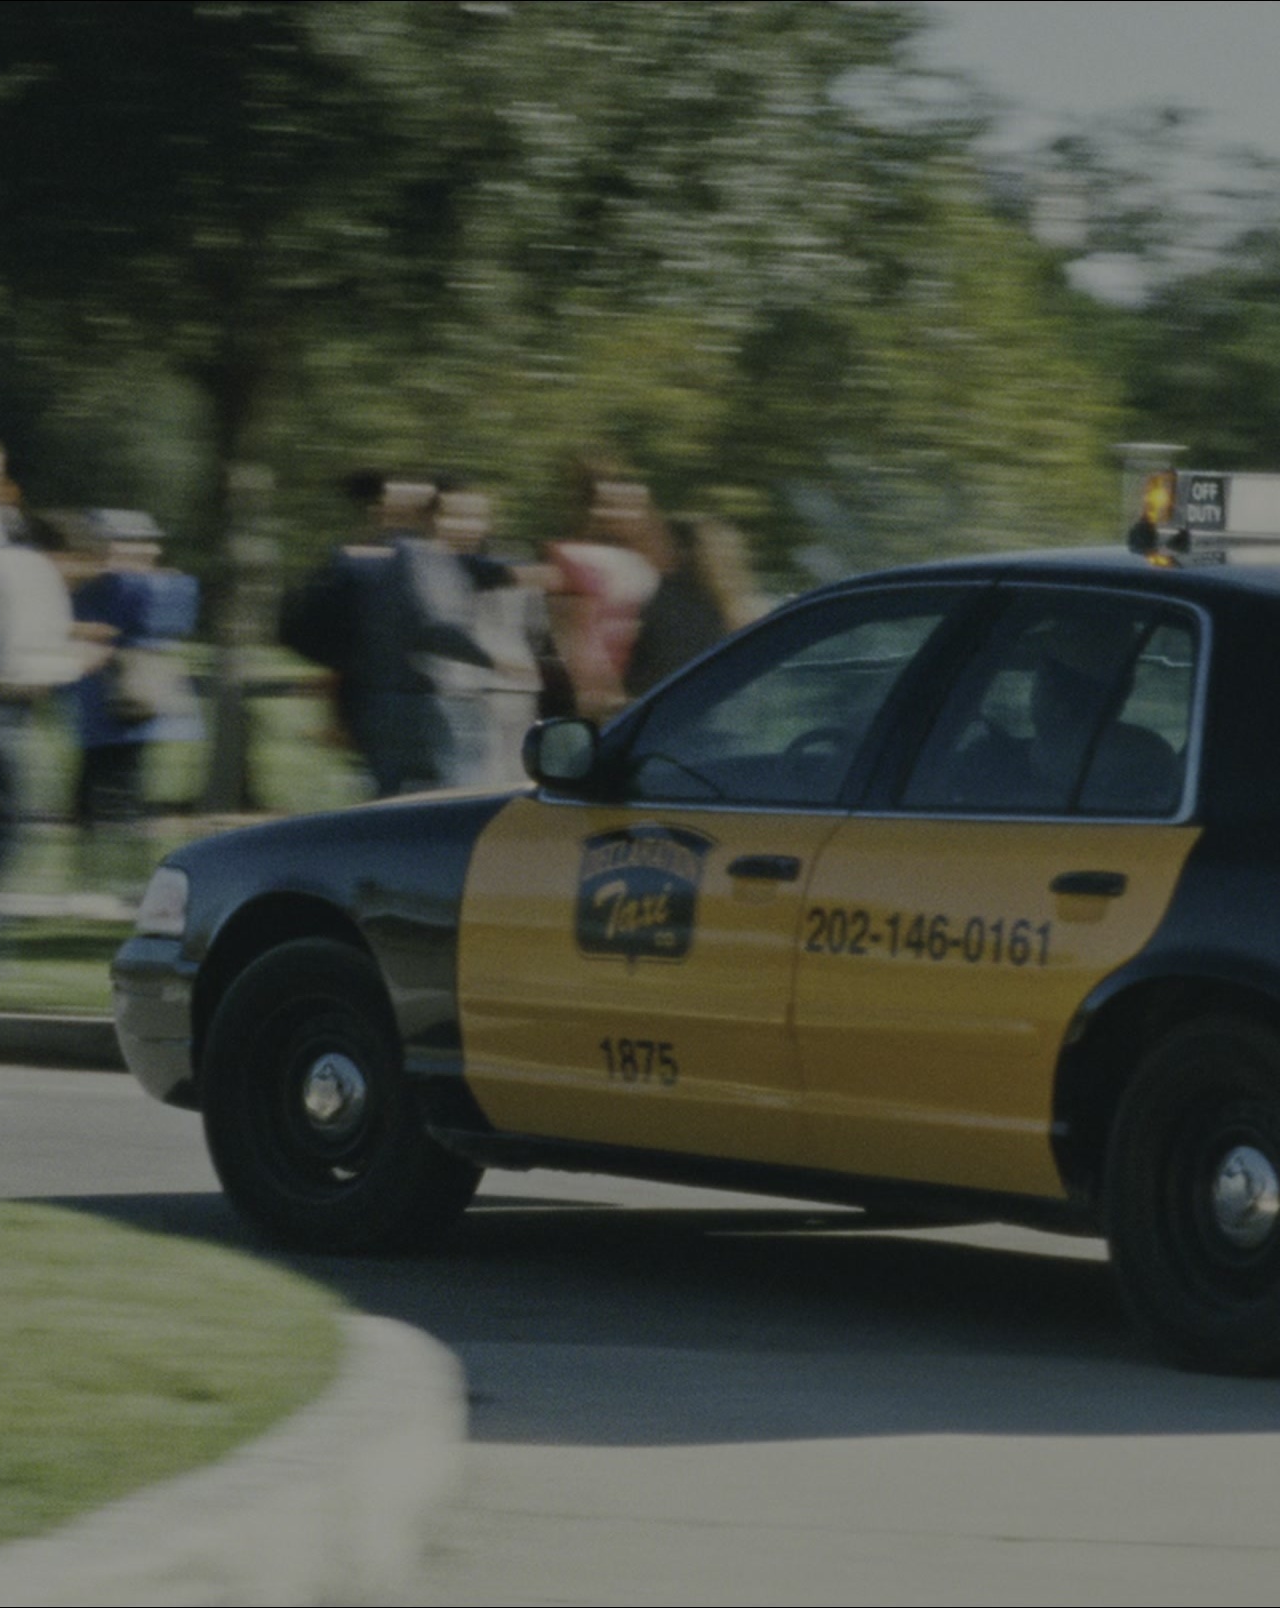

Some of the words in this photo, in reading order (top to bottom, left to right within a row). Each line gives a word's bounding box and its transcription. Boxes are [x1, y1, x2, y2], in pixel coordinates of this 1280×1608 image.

[1186, 504, 1221, 522] DUTY
[1192, 481, 1218, 500] OFF
[593, 880, 674, 939] Taxi
[805, 907, 1052, 966] 202-146-0161
[599, 1036, 679, 1088] 1875
